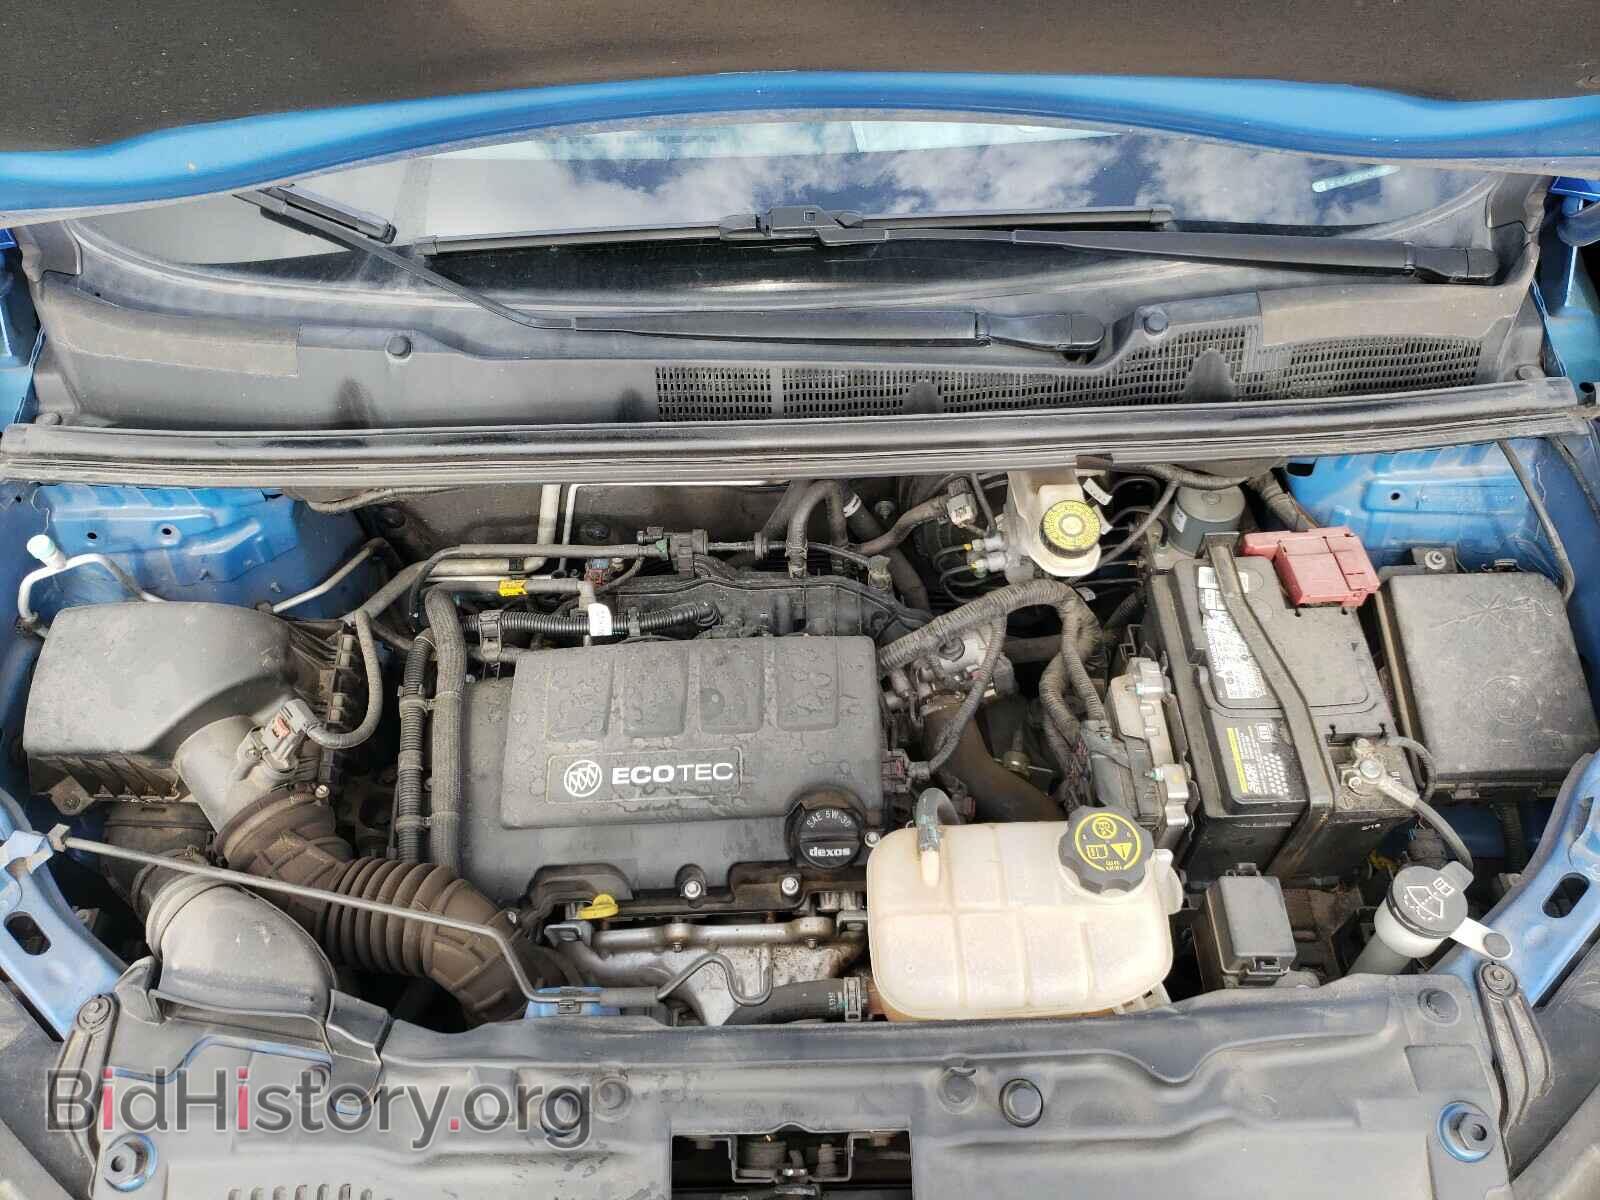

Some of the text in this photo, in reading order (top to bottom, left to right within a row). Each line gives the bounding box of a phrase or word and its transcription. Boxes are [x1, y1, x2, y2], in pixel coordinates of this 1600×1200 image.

[612, 763, 733, 784] ECOTEC
[806, 812, 823, 828] SAE
[809, 846, 851, 857] dexos
